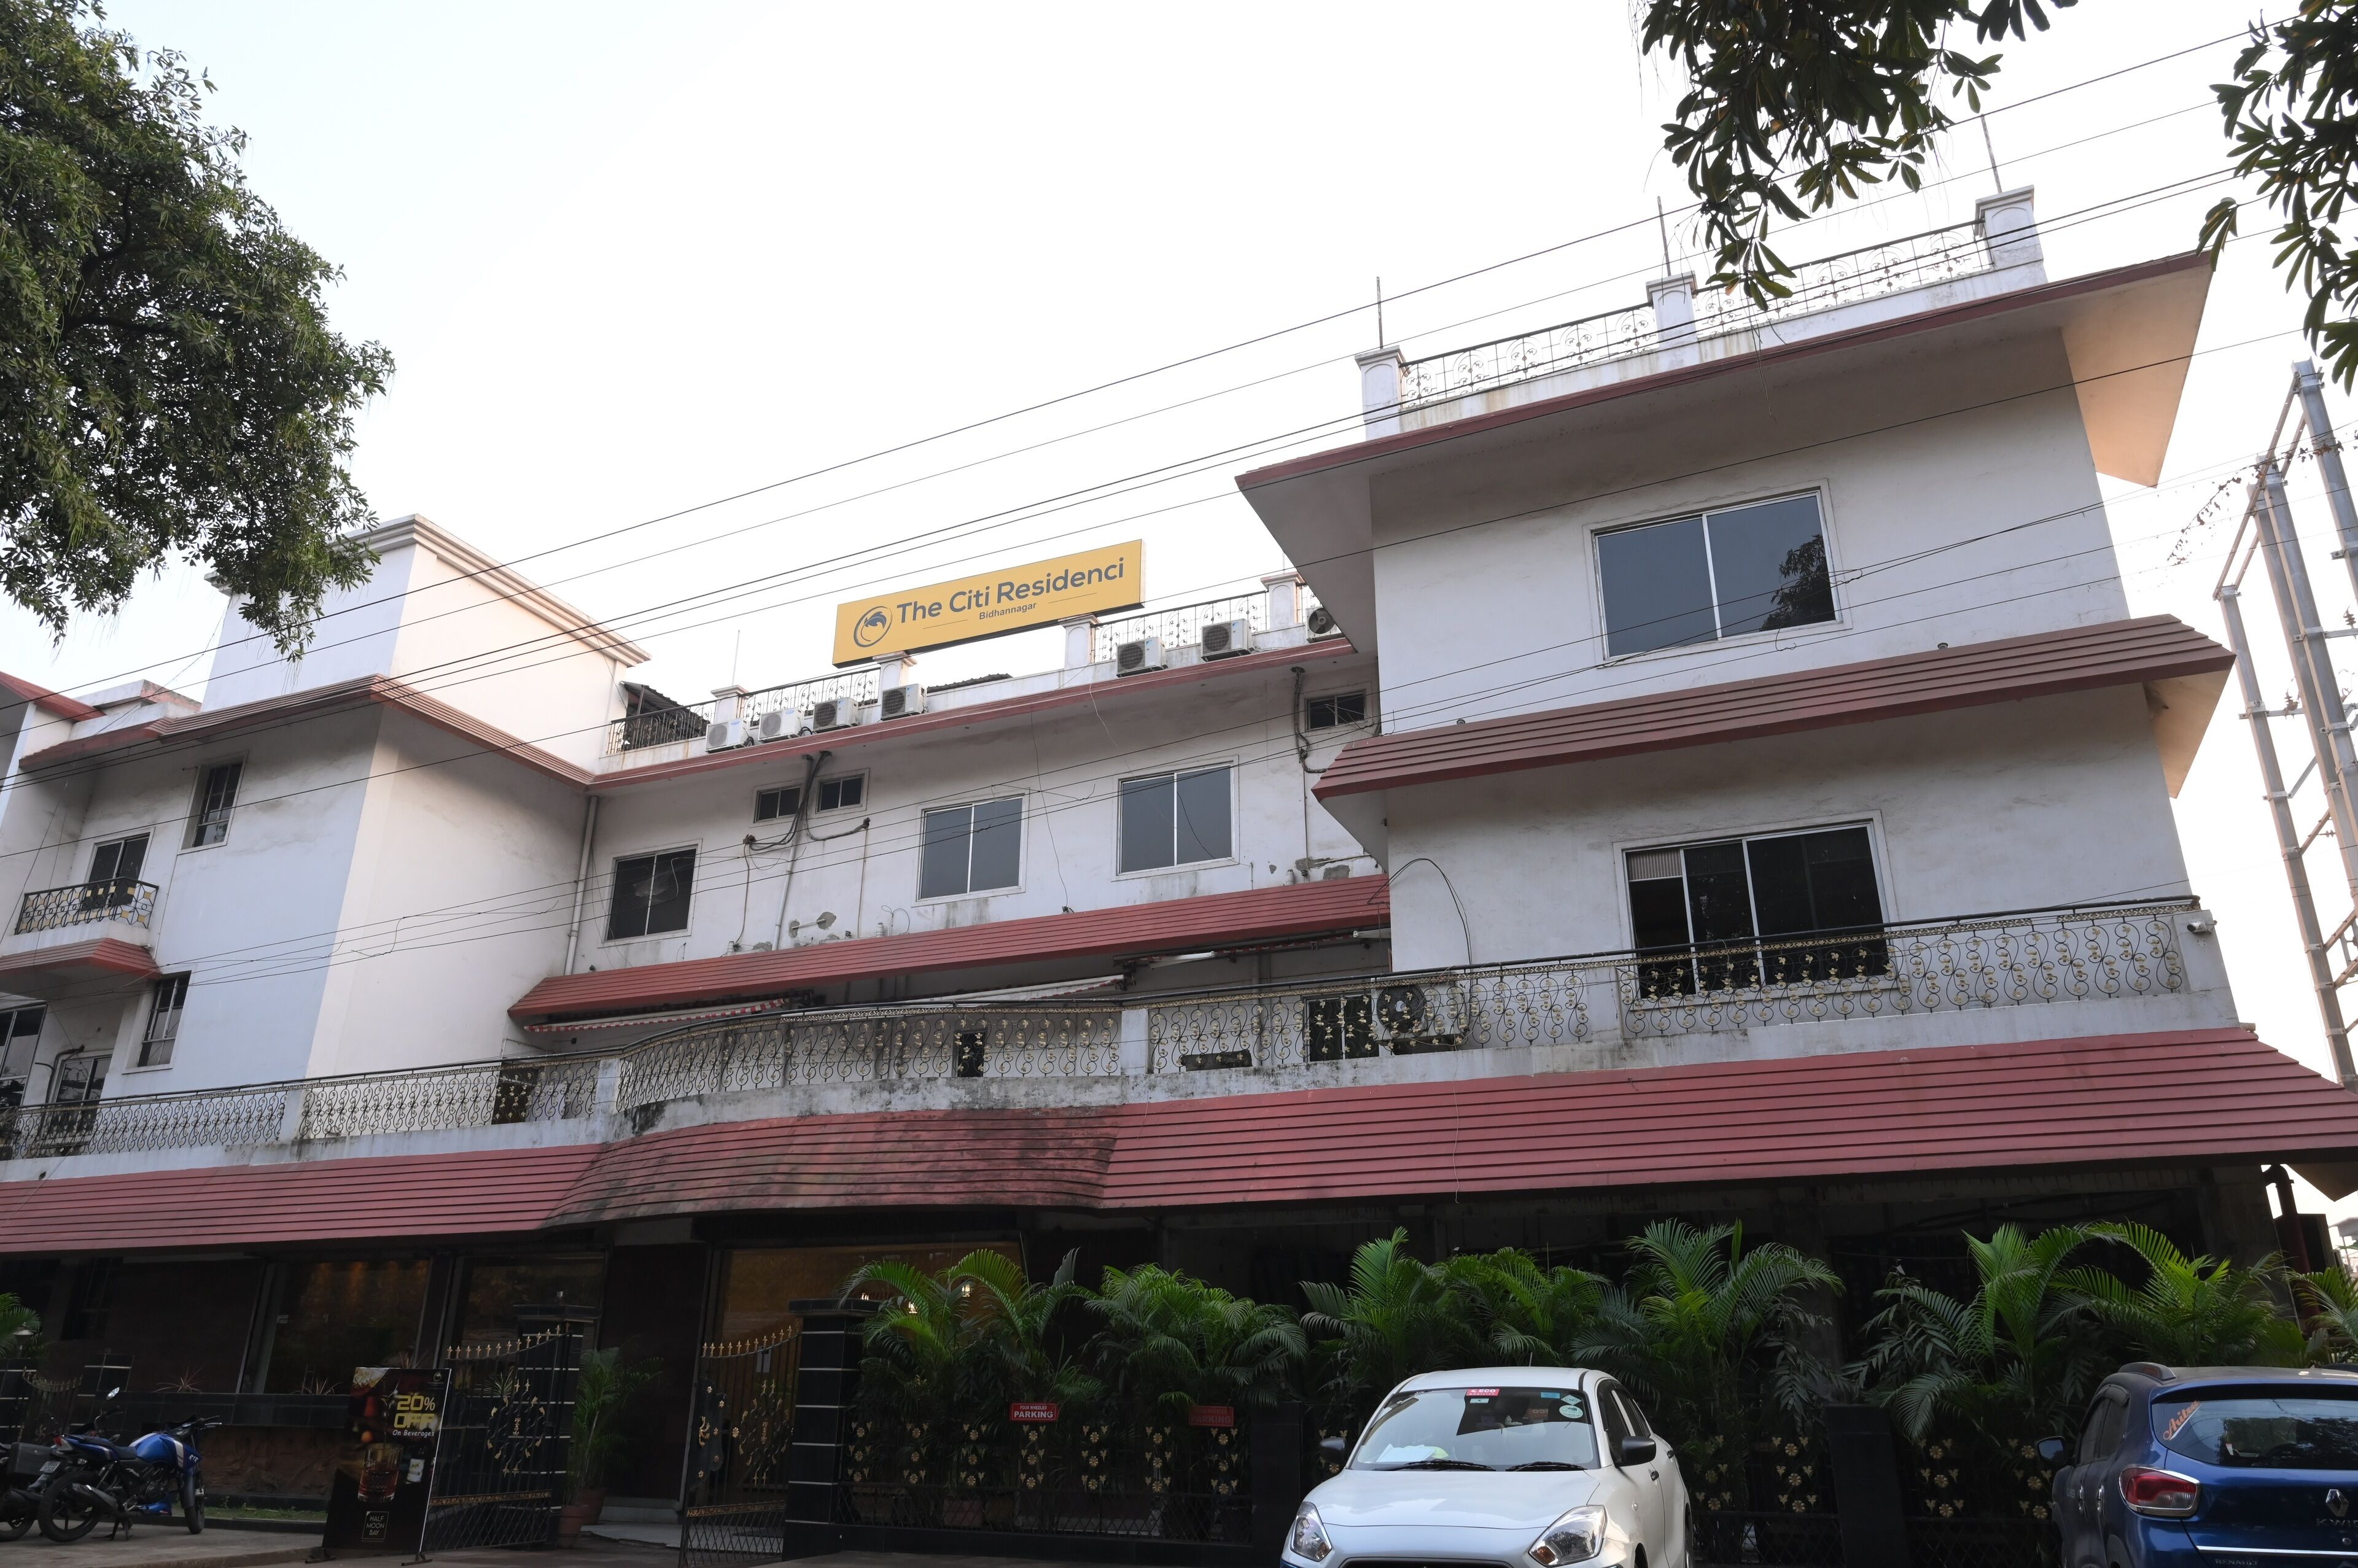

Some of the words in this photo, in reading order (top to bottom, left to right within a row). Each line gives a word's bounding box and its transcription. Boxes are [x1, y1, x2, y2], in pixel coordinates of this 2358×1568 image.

[897, 600, 943, 623] The
[949, 586, 989, 613] Citi
[997, 557, 1124, 604] Residenci
[979, 602, 1037, 620] Bidhannagar
[397, 1395, 435, 1411] 20%
[394, 1413, 435, 1428] OFF
[1193, 1415, 1231, 1424] PARKING
[403, 1429, 435, 1438] Beverages
